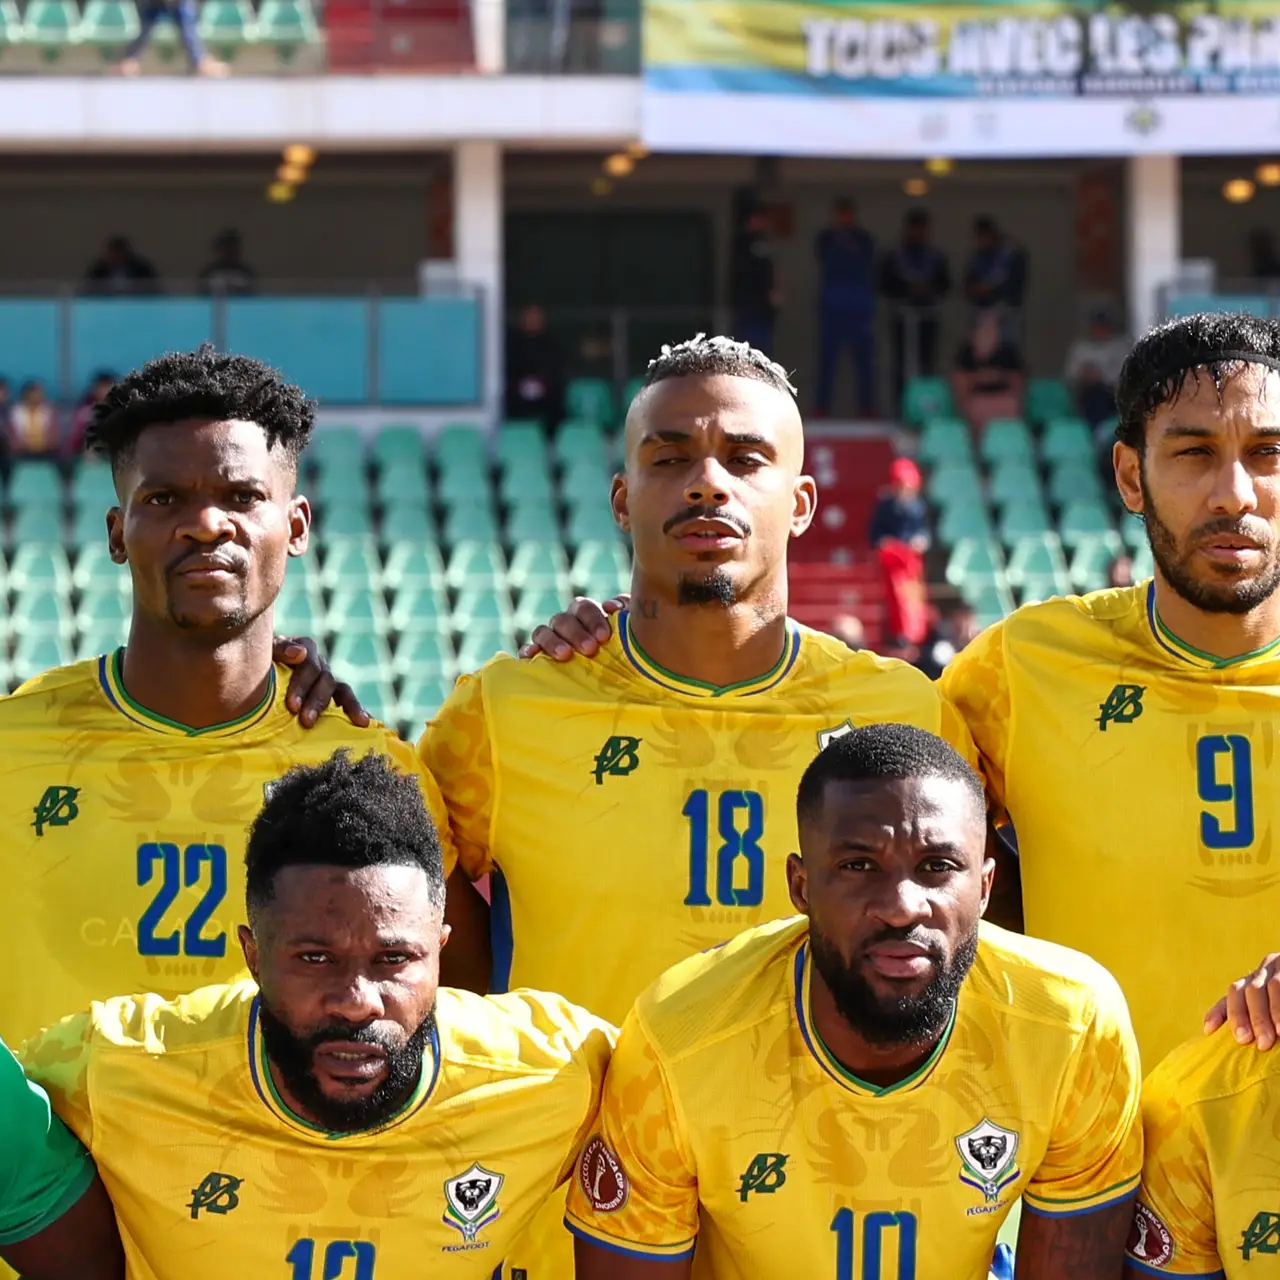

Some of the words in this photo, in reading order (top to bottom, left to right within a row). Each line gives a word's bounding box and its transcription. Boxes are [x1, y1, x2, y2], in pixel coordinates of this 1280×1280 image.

[804, 18, 938, 80] TOUS
[948, 17, 1082, 76] AVEC
[1088, 14, 1180, 73] LES
[681, 788, 765, 907] 18
[1196, 734, 1255, 850] 9
[136, 841, 228, 958] 22
[441, 1241, 490, 1253] FEGAFOOT
